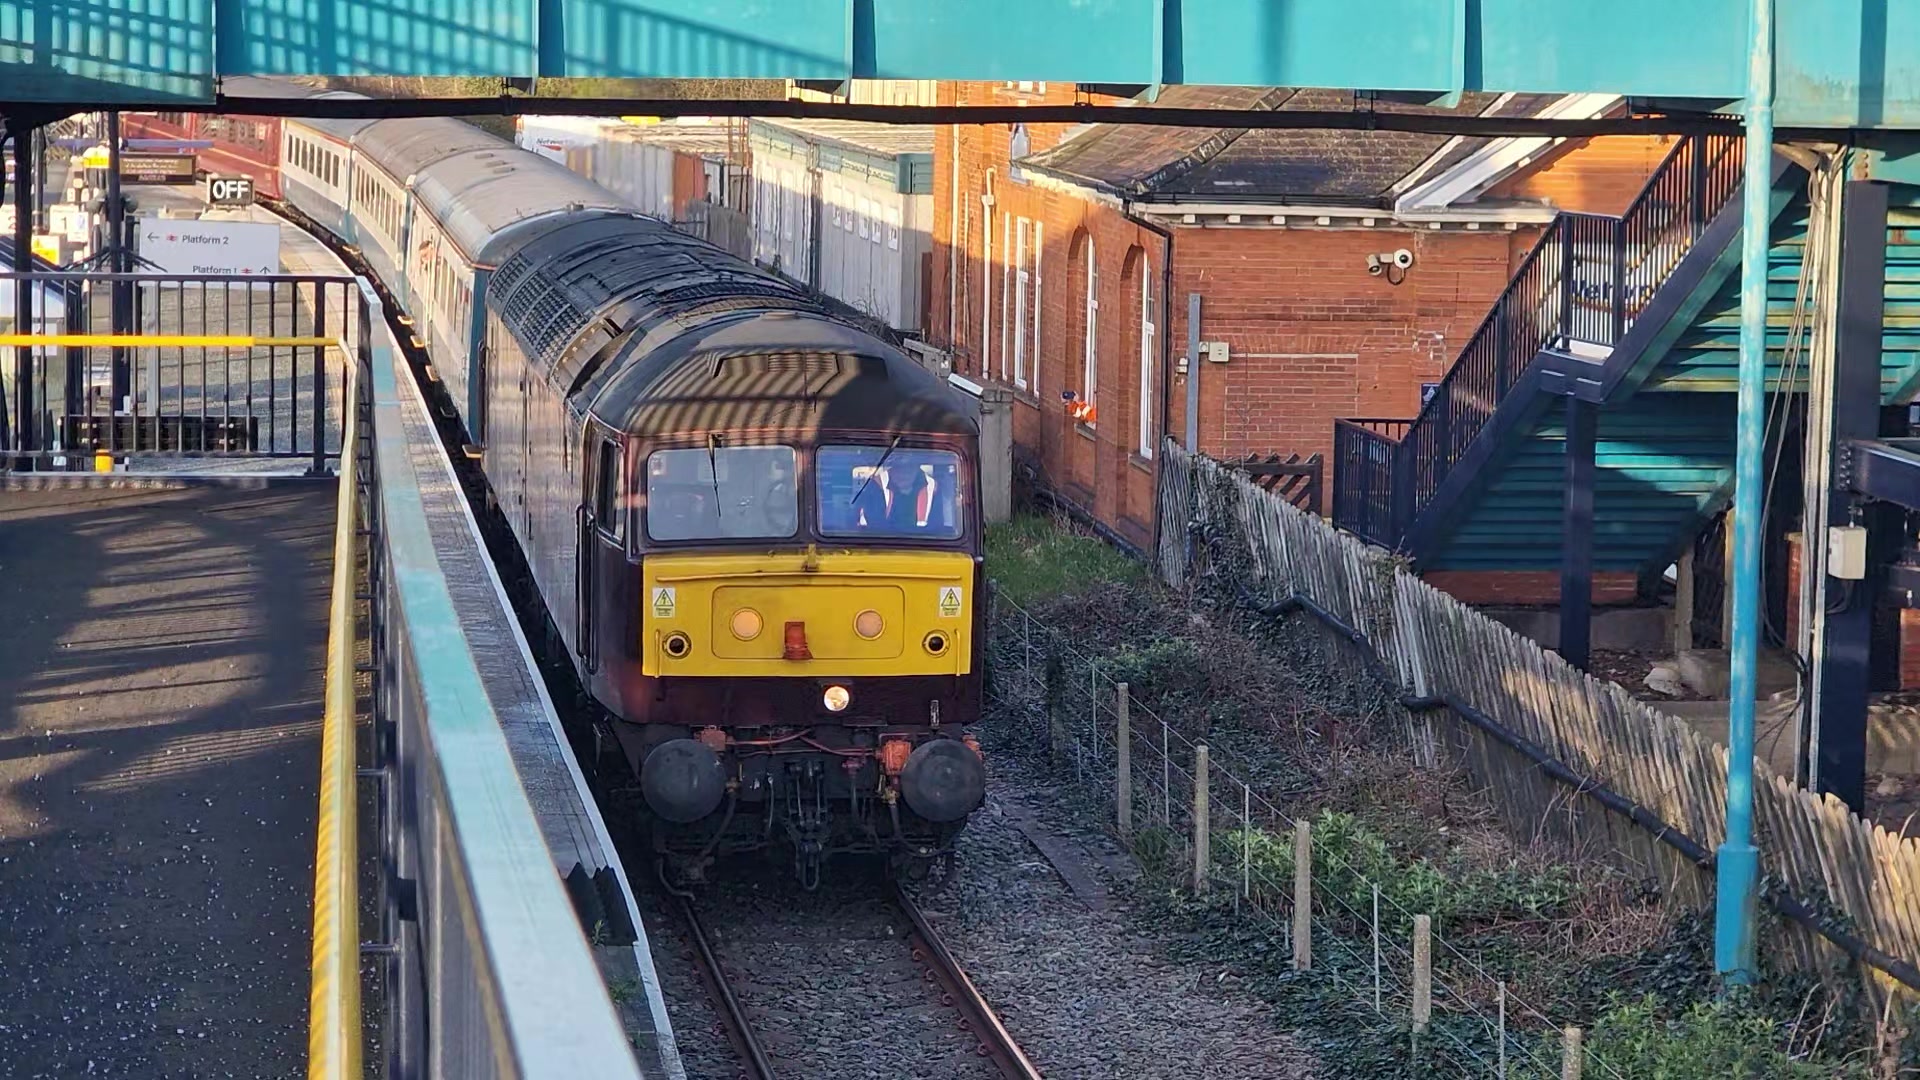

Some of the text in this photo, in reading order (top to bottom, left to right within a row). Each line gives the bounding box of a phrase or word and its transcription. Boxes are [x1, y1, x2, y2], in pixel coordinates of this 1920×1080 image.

[212, 180, 249, 199] OFF
[182, 235, 229, 245] Platform 2
[192, 265, 232, 275] Platform
